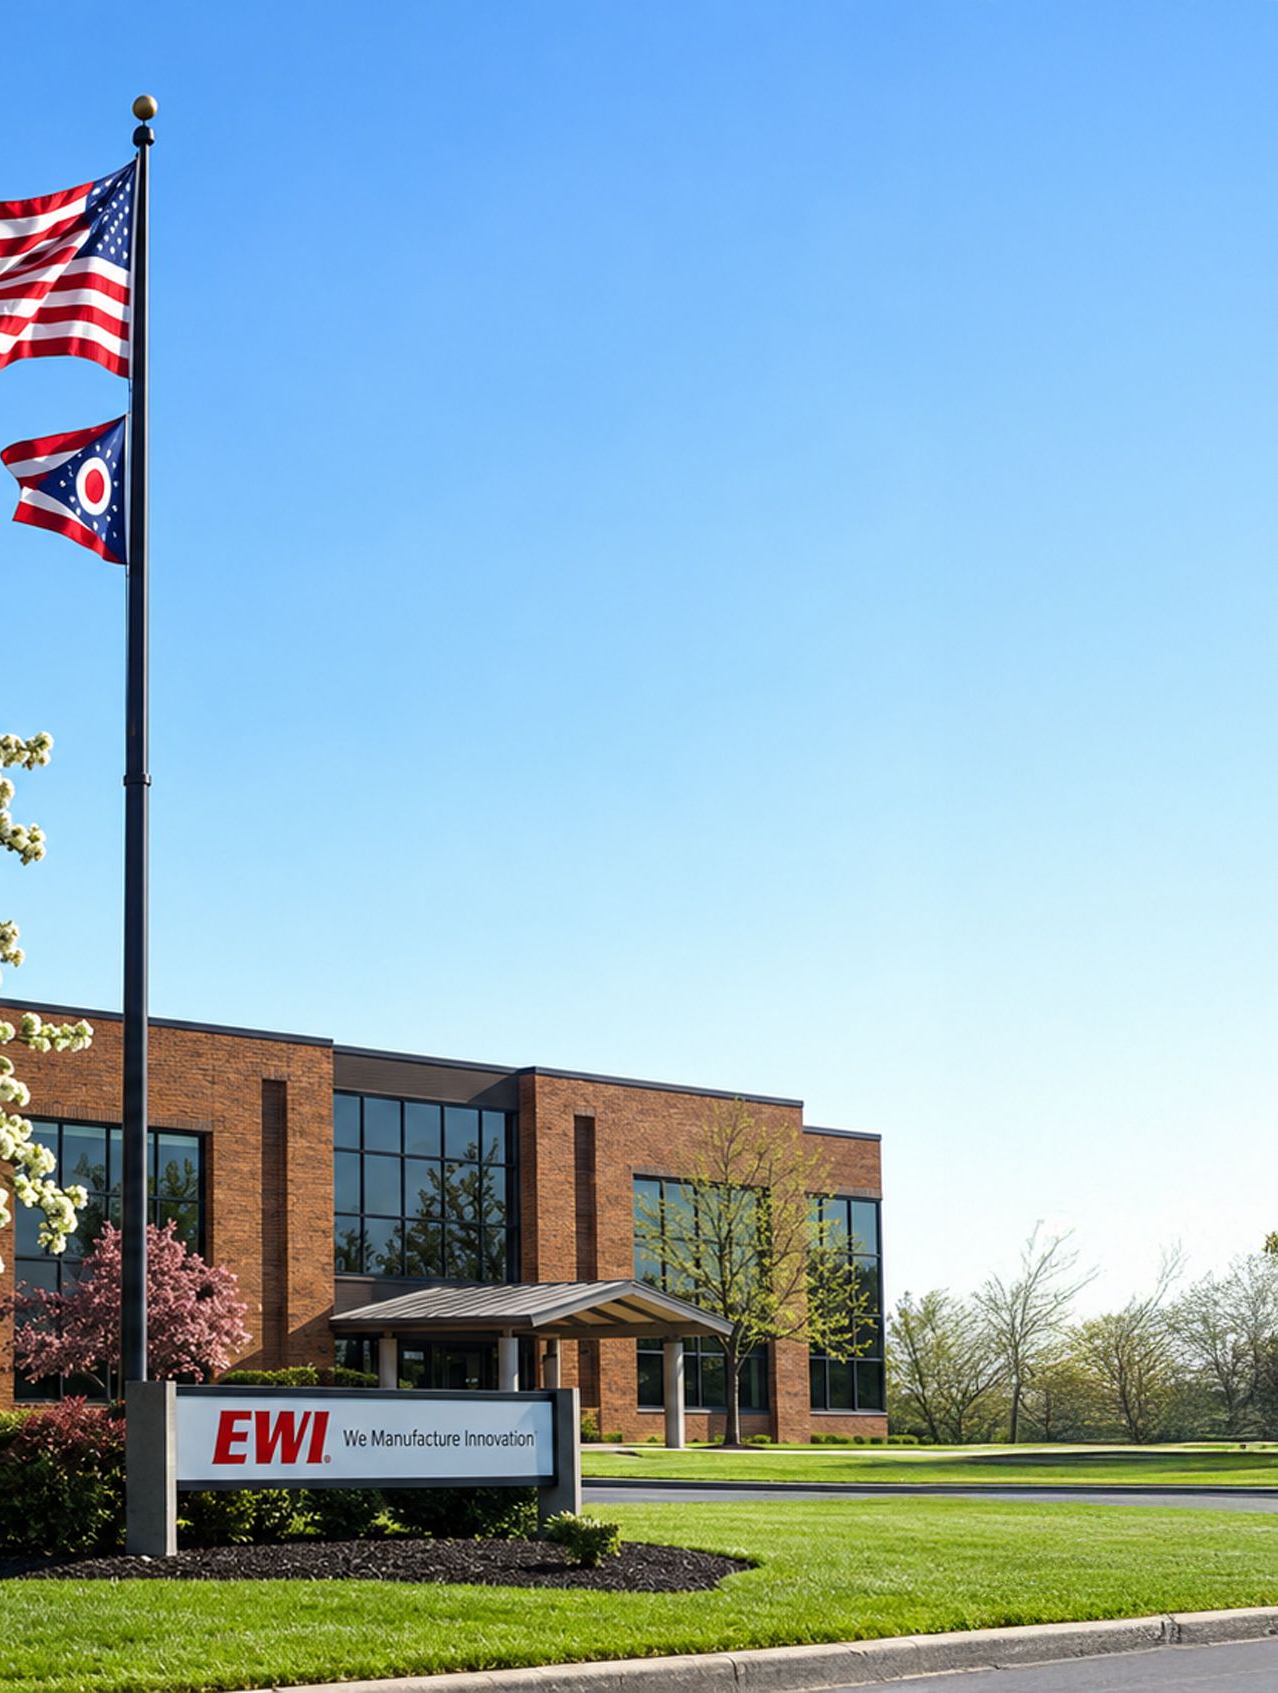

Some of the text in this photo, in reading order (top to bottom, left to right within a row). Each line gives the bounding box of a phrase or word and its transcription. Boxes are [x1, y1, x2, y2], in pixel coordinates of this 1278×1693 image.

[343, 1428, 535, 1447] We Manufacture Innovation
